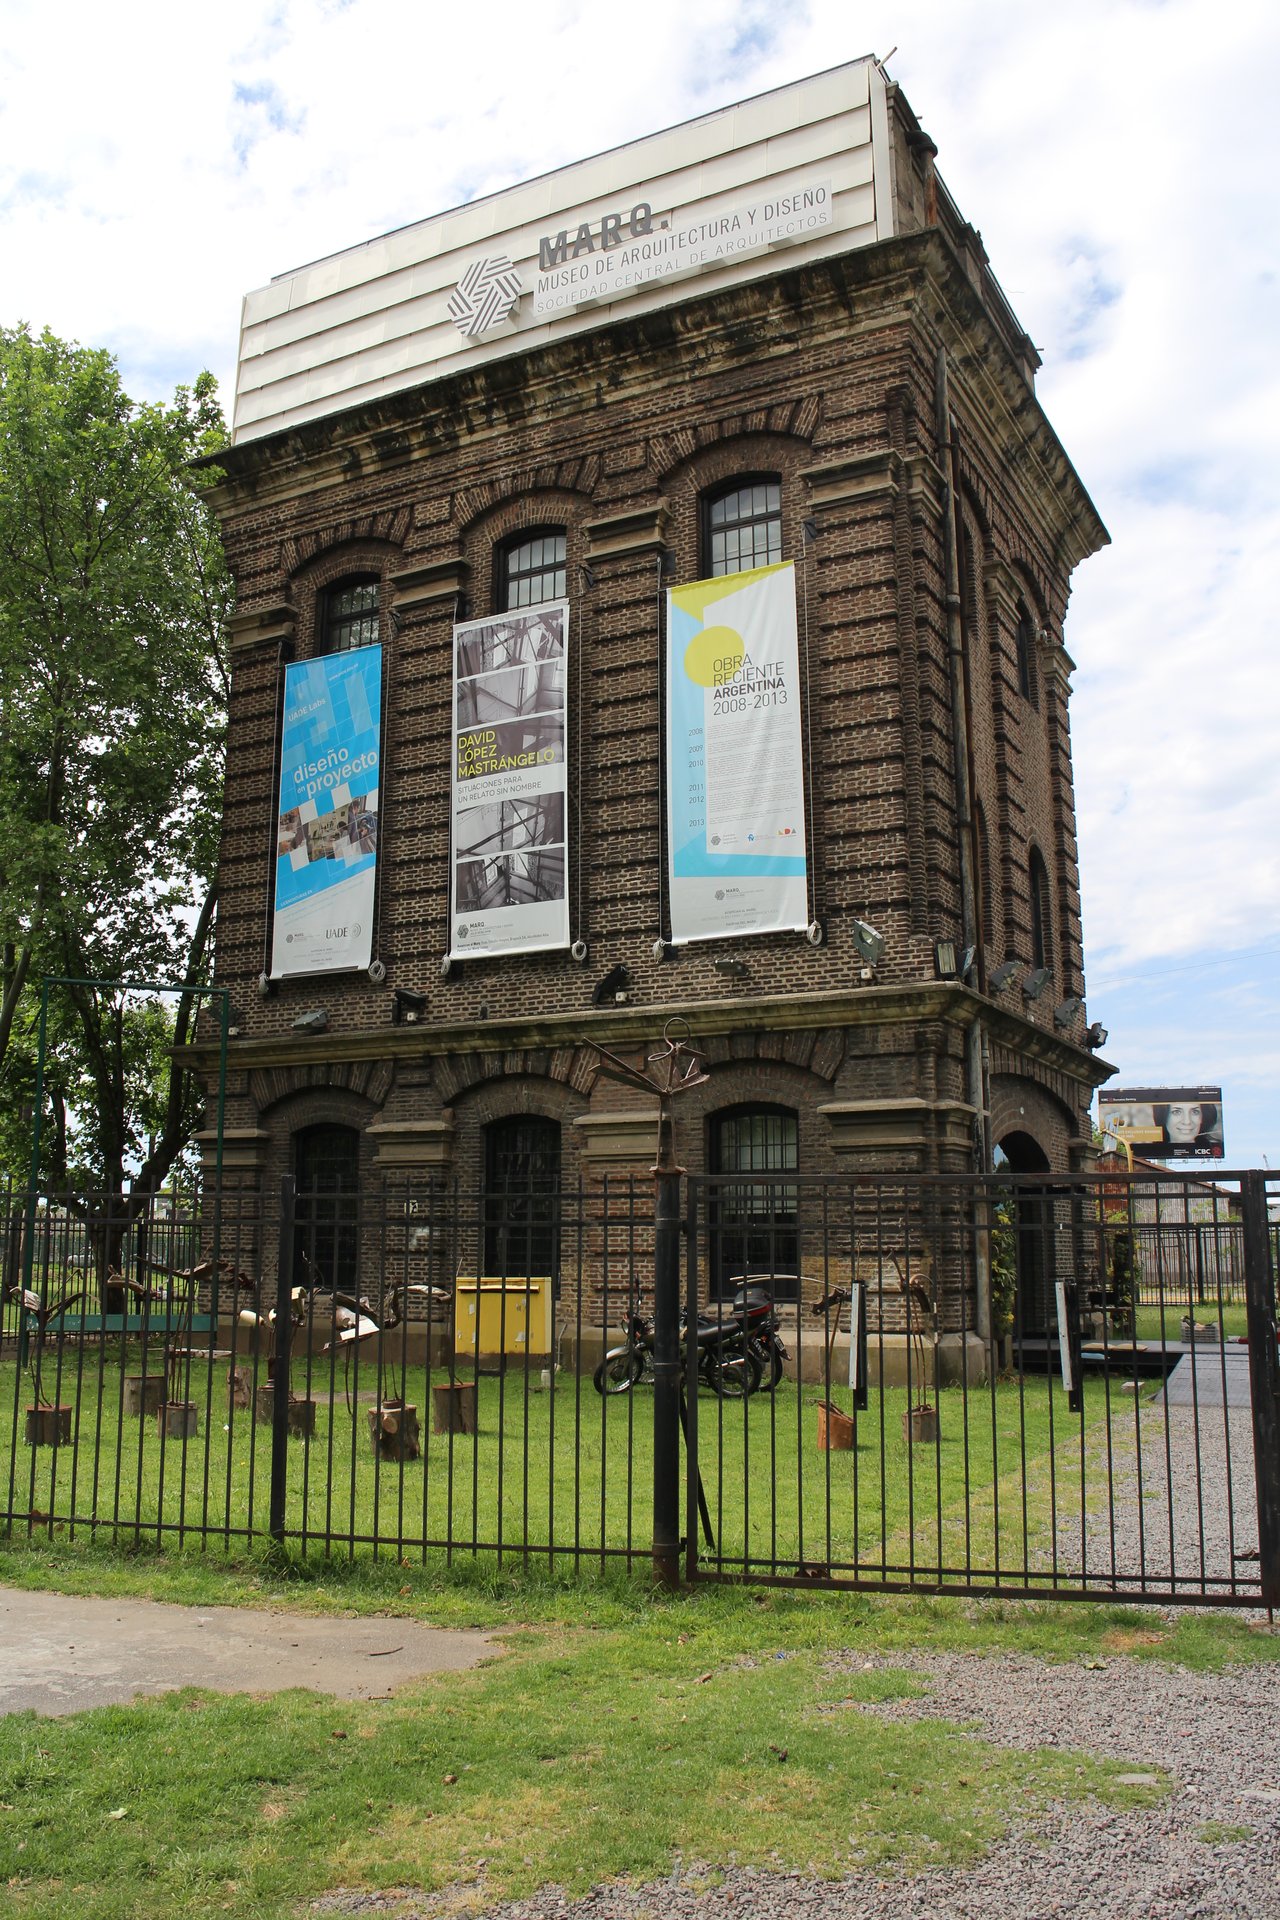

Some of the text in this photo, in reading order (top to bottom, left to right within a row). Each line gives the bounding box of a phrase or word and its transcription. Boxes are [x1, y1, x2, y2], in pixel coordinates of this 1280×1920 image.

[537, 187, 826, 294] MUSEO DE ARQUITECTURA Y DISEÑO
[539, 202, 669, 272] MARQ.
[537, 212, 827, 313] SOCIEDAD CENTRAL DE ARQUITECTOS
[713, 653, 753, 673] OBRA
[713, 661, 785, 688] RECIENTE
[713, 677, 786, 700] ARGENTINA
[713, 690, 788, 716] 2008-2013
[288, 706, 308, 722] UADE
[458, 730, 496, 750] DAVID
[688, 727, 703, 737] 2008
[458, 744, 497, 764] LÓPEZ
[688, 745, 704, 754] 2009
[293, 747, 349, 784] diseño
[458, 748, 555, 779] MASTRÁNGELO
[688, 759, 704, 768] 2010
[306, 751, 378, 800] proyecto
[457, 775, 523, 795] SITUACIONES PARA
[457, 781, 542, 804] UN RELATO SIN NOMBRE
[688, 783, 704, 792] 2011
[688, 796, 705, 804] 2012
[689, 819, 705, 828] 2013
[325, 926, 349, 940] UADE
